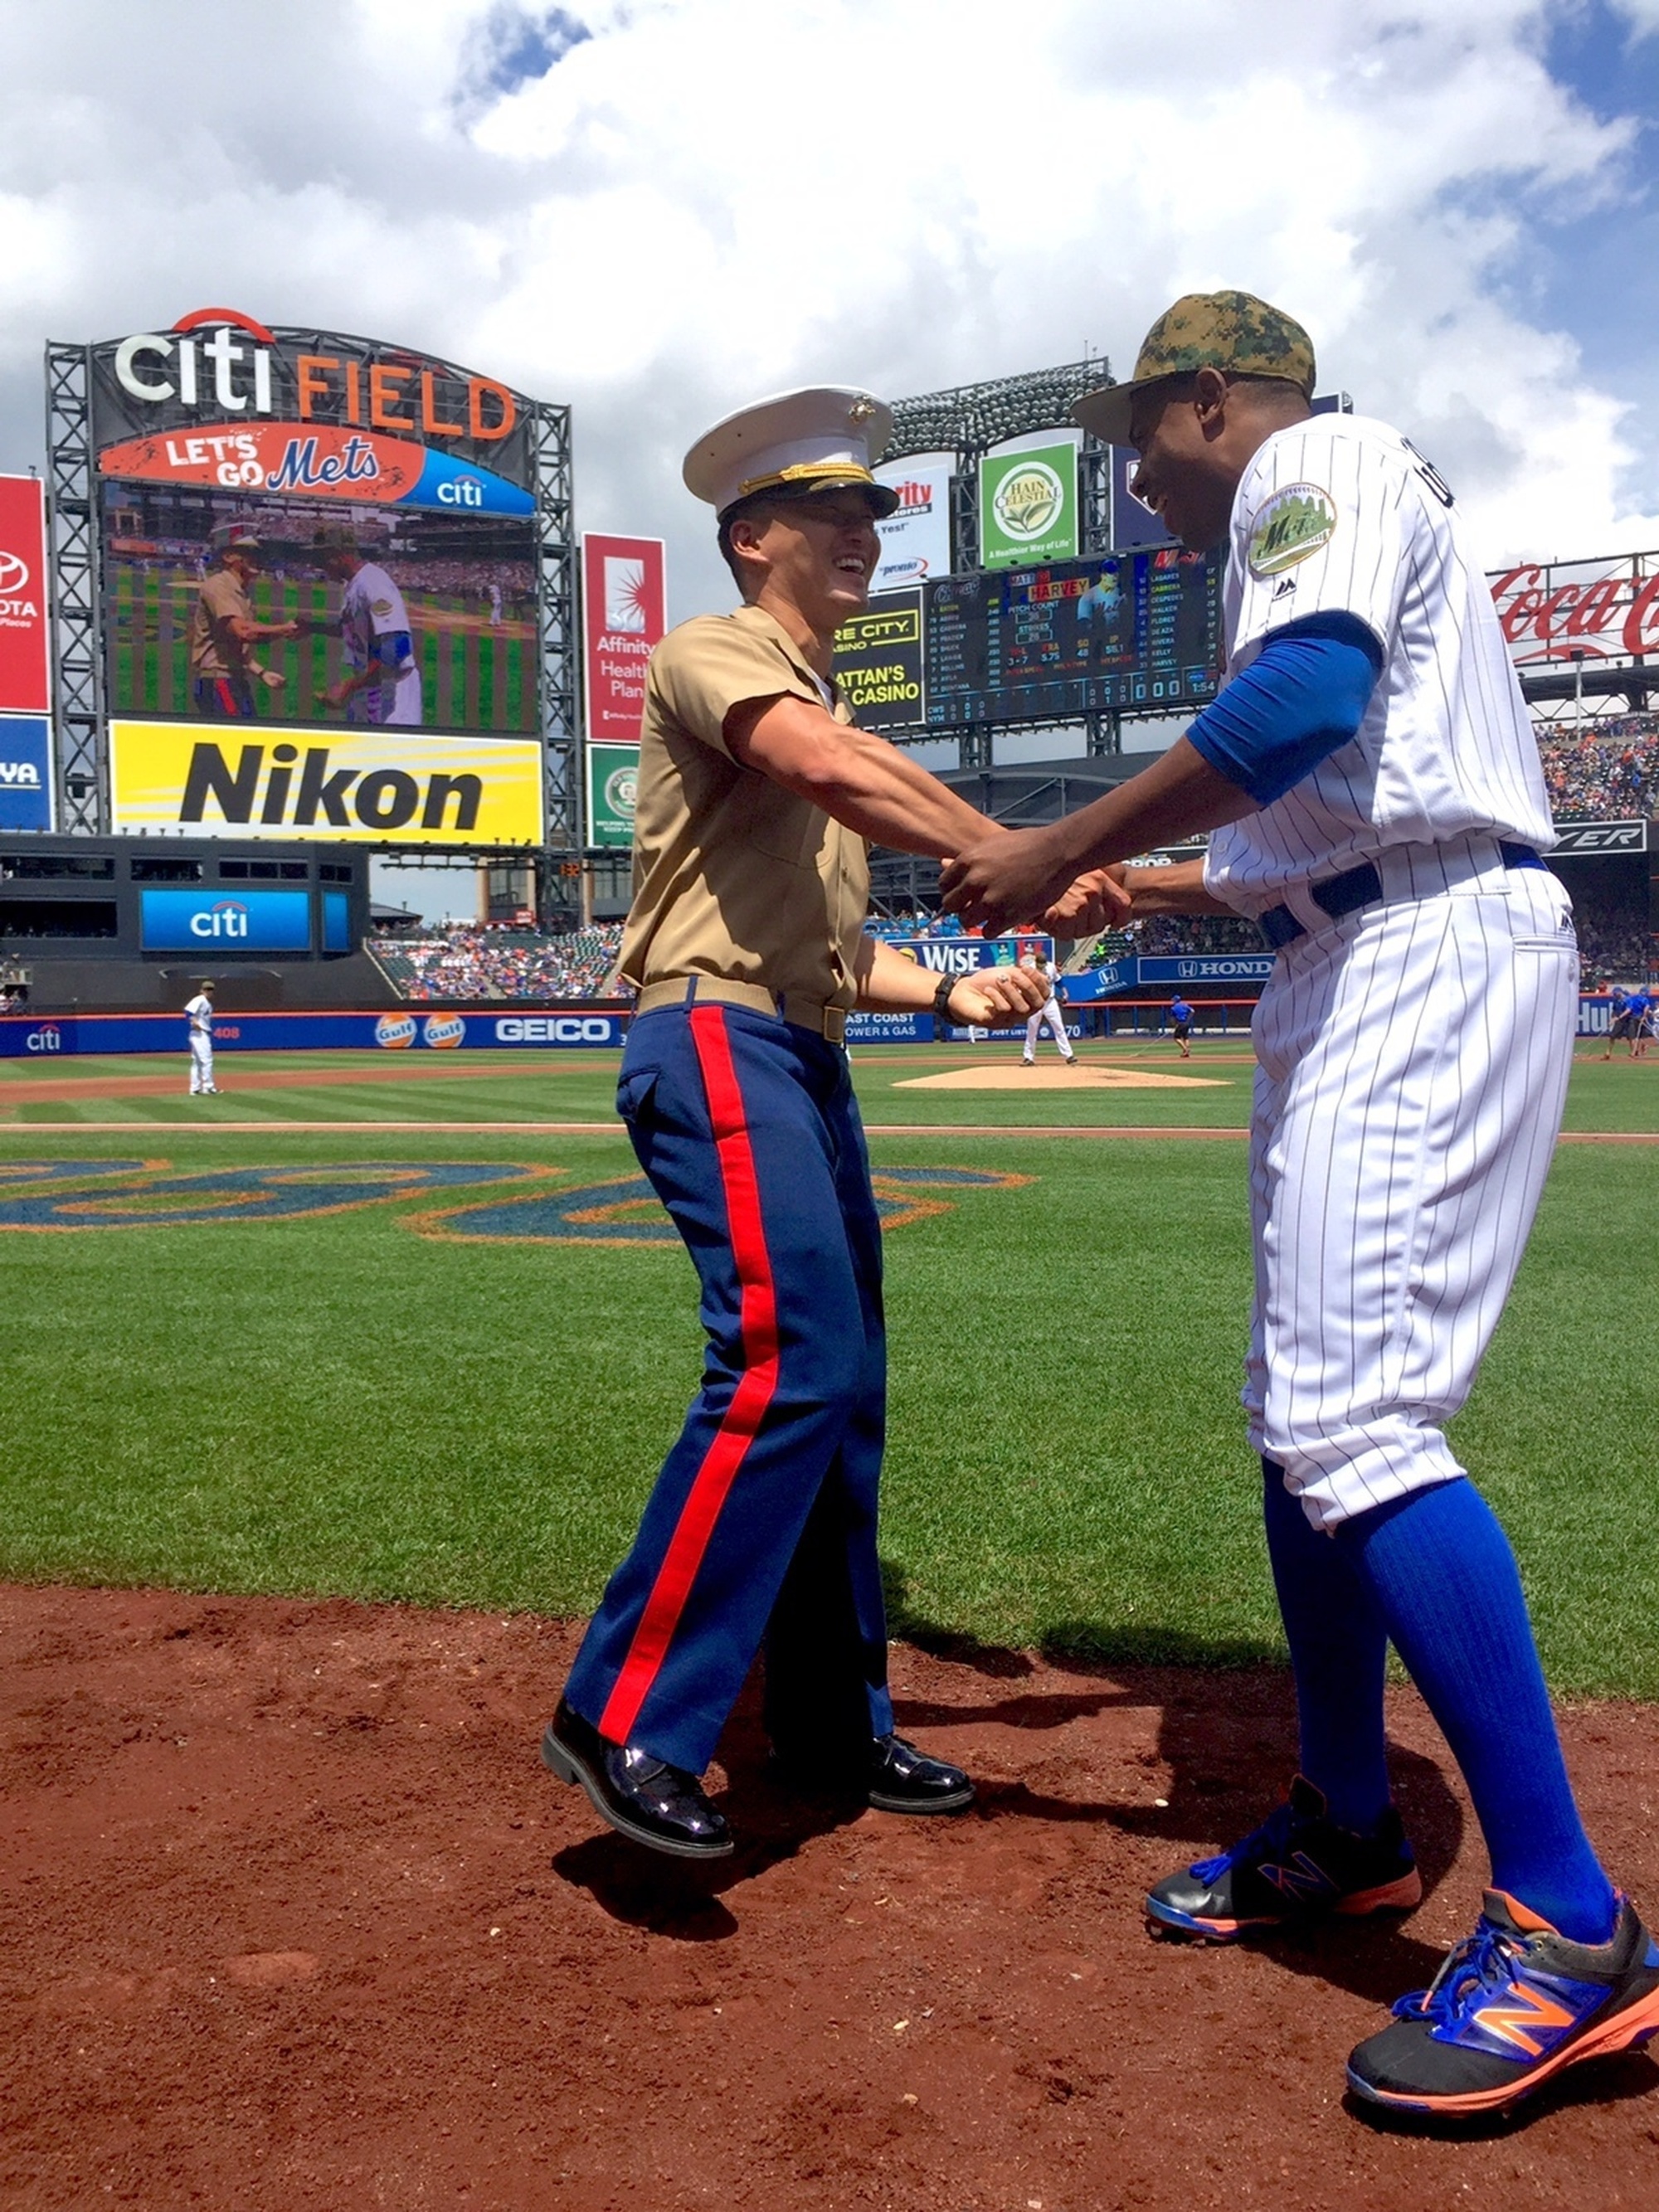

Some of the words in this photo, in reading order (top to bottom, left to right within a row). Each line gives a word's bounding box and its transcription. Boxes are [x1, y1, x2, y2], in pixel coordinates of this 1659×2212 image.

[297, 355, 516, 440] FIELD
[166, 435, 257, 466] LET'S
[217, 461, 264, 487] GO
[266, 435, 380, 489] Mets
[1011, 481, 1044, 494] HAIN
[995, 487, 1061, 509] CELESTIAL
[995, 547, 1029, 557] Healthier
[1046, 541, 1054, 549] of
[1031, 579, 1088, 600] HARVEY
[1032, 600, 1059, 611] COUNT
[596, 636, 655, 659] Affinity
[611, 680, 645, 698] Plan
[852, 683, 919, 706] CASINO
[1153, 682, 1163, 697] 0
[1169, 680, 1180, 696] 0
[1193, 681, 1215, 693] 1:54
[179, 742, 483, 830] Nikon
[190, 907, 247, 937] citi
[922, 946, 980, 973] WISE
[1095, 981, 1128, 994] HONDA
[845, 1013, 870, 1024] AST
[873, 1013, 915, 1023] COAST
[213, 1026, 240, 1039] 408
[379, 1023, 411, 1040] Gulf
[428, 1023, 460, 1040] Gulf
[495, 1018, 611, 1042] GEICO
[882, 1026, 890, 1037] &
[892, 1025, 917, 1037] GAS
[991, 1028, 1010, 1037] JUST
[27, 1029, 60, 1051] citi
